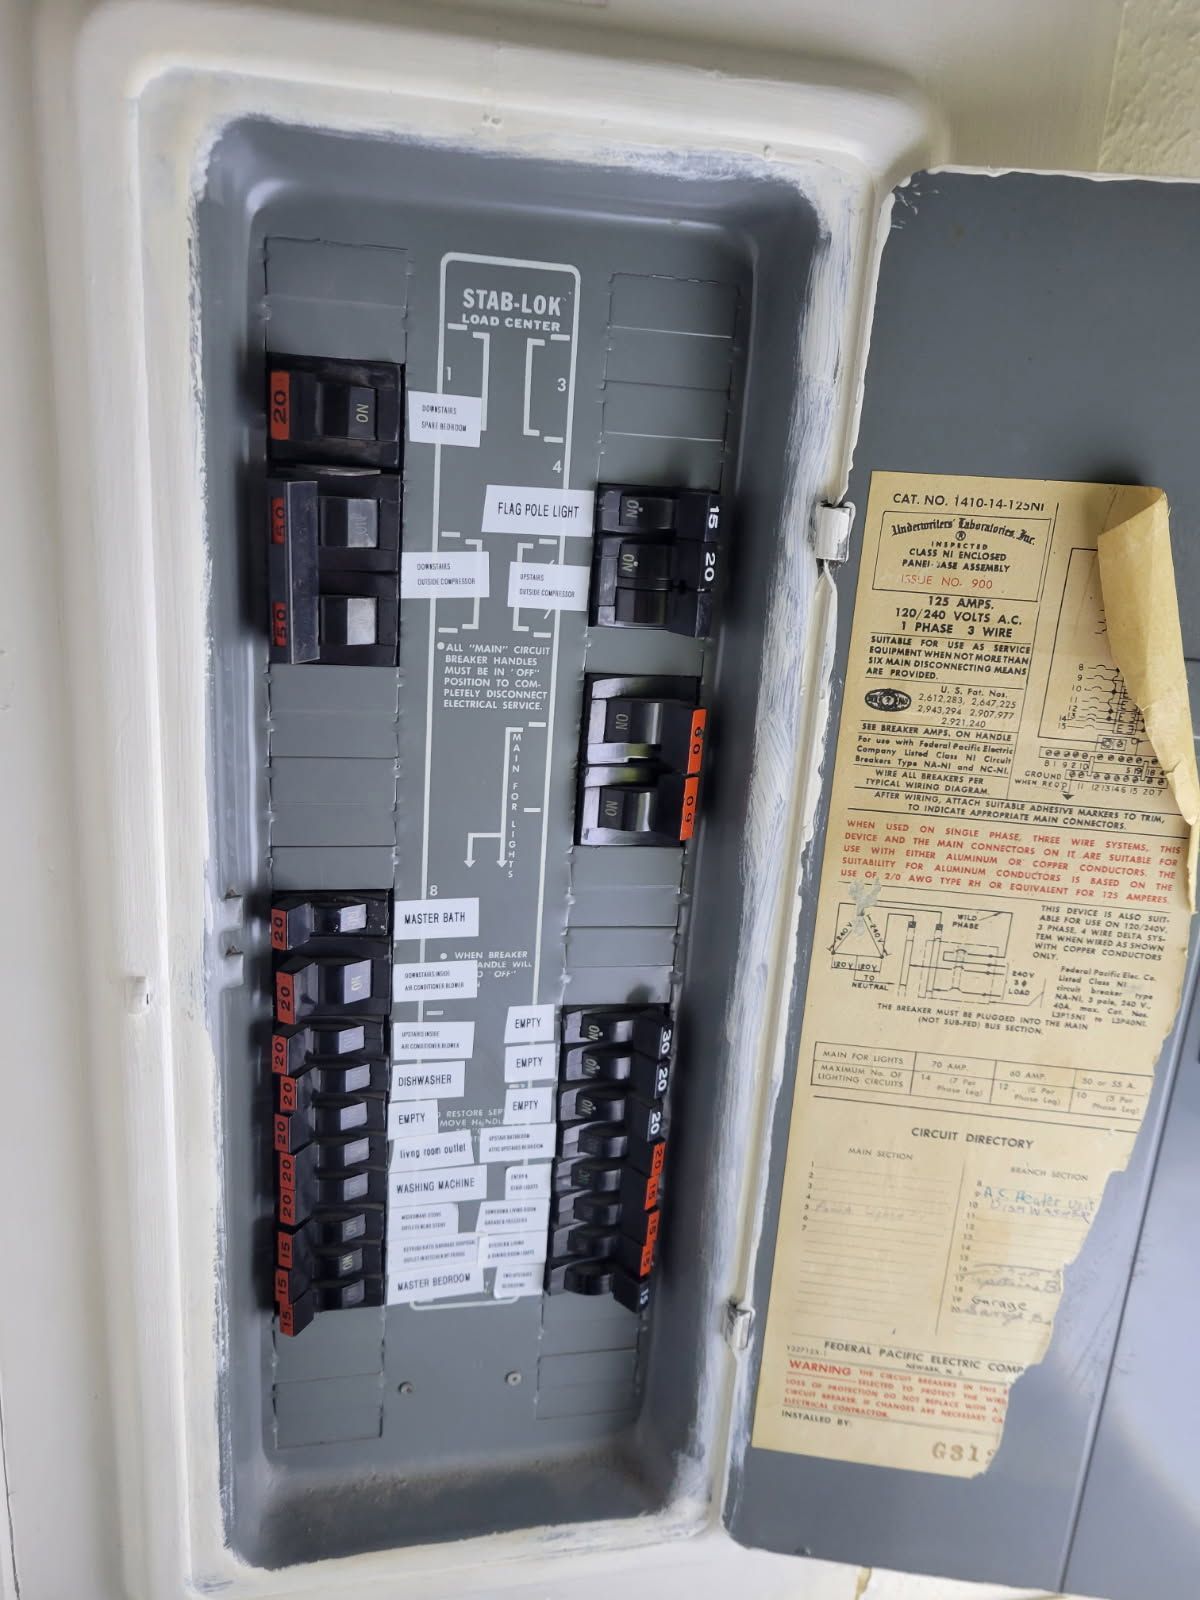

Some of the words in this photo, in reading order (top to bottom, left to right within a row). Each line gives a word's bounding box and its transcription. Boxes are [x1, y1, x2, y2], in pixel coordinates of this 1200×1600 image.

[463, 289, 560, 315] STAB-LOK
[462, 313, 499, 325] LOAD
[504, 317, 560, 331] CENTER
[447, 366, 452, 381] 1
[557, 378, 566, 392] 3
[273, 391, 287, 425] 20
[356, 403, 369, 423] ON
[439, 422, 466, 431] BEDROOM
[552, 460, 562, 473] 4
[892, 493, 919, 504] CAT.
[924, 494, 947, 505] NO.
[497, 501, 521, 515] FLAG
[524, 503, 548, 516] POLE
[552, 505, 579, 517] LIGHT
[626, 500, 640, 518] ON
[708, 506, 720, 529] 15
[908, 547, 937, 556] CLASS
[942, 549, 953, 558] NI
[958, 551, 1006, 561] ENCLOSED
[931, 541, 987, 550] INSPECTED
[622, 554, 636, 572] ON
[704, 552, 716, 581] 20
[962, 562, 1010, 572] ASSEMBLY
[940, 576, 962, 586] NO.
[971, 578, 992, 589] 900
[540, 589, 574, 597] COMPRESSOR
[928, 595, 949, 606] 125
[956, 598, 993, 609] AMPS.
[896, 607, 945, 619] 120/240
[953, 611, 990, 622] VOLTS
[997, 614, 1021, 625] A.C.
[901, 620, 906, 630] 1
[914, 622, 953, 633] PHASE
[967, 625, 974, 635] 3
[982, 626, 1012, 637] WIRE
[446, 643, 463, 651] ALL
[513, 645, 550, 654] CIRCUIT
[871, 635, 912, 645] SUITABLE
[920, 638, 938, 647] FOR
[947, 640, 964, 649] USE
[971, 642, 984, 650] AS
[993, 644, 1030, 653] SERVICE
[445, 654, 487, 663] BREAKER
[493, 656, 537, 665] HANDLES
[869, 646, 921, 656] EQUIPMENT
[924, 650, 952, 658] WHEN
[953, 652, 974, 660] NOT
[974, 653, 1001, 662] MORE
[1003, 655, 1028, 664] THAN
[444, 666, 471, 674] MUST
[476, 666, 488, 675] BE
[493, 667, 504, 675] IN
[866, 667, 883, 675] ARE
[890, 668, 937, 679] PROVIDED.
[868, 656, 882, 664] SIX
[885, 657, 910, 666] MAIN
[913, 660, 991, 672] DISCONNECTING
[993, 666, 1026, 675] MEANS
[444, 677, 490, 686] POSITION
[495, 678, 509, 687] TO
[514, 679, 540, 687] COM-
[443, 688, 480, 697] PLETELY
[486, 689, 547, 698] DISCONNECT
[443, 699, 497, 708] ELECTRICAL
[502, 701, 542, 709] SERVICE.
[616, 713, 629, 730] ON
[513, 734, 522, 773] MAIN
[604, 800, 618, 817] ON
[924, 805, 965, 815] INDICATE
[969, 809, 1028, 820] APPROPRIATE
[1032, 815, 1058, 823] MAIN
[1062, 817, 1125, 829] CONNECTORS.
[847, 820, 875, 828] WHEN
[886, 823, 909, 831] USED
[919, 825, 934, 833] ON
[944, 827, 978, 837] SINGLE
[1033, 834, 1060, 844] THREE
[1071, 838, 1095, 846] WIRE
[1160, 845, 1181, 854] THIS
[430, 885, 437, 896] 8
[404, 912, 439, 924] MASTER
[443, 911, 465, 922] BATH
[273, 916, 284, 942] 20
[280, 986, 291, 1012] 20
[514, 1017, 541, 1028] EMPTY
[588, 1025, 600, 1040] ON
[661, 1029, 672, 1054] 30
[274, 1042, 285, 1067] 20
[516, 1056, 542, 1068] EMPTY
[398, 1074, 451, 1086] DISHWASHER
[658, 1067, 668, 1091] 20
[283, 1082, 293, 1106] 20
[446, 1109, 482, 1117] RESTORE
[512, 1100, 538, 1110] EMPTY
[398, 1112, 424, 1124] EMPTY
[650, 1111, 662, 1135] 20
[277, 1121, 286, 1142] 20
[911, 1127, 958, 1140] CIRCUIT
[965, 1133, 1033, 1148] DIRECTORY
[423, 1147, 440, 1156] room
[443, 1143, 465, 1153] outlet
[876, 1150, 912, 1160] SECTION
[282, 1160, 292, 1182] 20
[396, 1181, 434, 1193] WASHING
[438, 1177, 474, 1189] MACHINE
[282, 1194, 292, 1218] 20
[281, 1242, 290, 1259] 15
[278, 1276, 287, 1294] 15
[397, 1278, 429, 1290] MASTER
[432, 1273, 470, 1286] BEDROOM
[282, 1308, 291, 1328] 15
[824, 1341, 871, 1354] FEDERAL
[878, 1348, 923, 1361] PACIFIC
[930, 1355, 979, 1368] ELECTRIC
[789, 1360, 850, 1375] WARNING
[781, 1410, 831, 1423] INSTALLED
